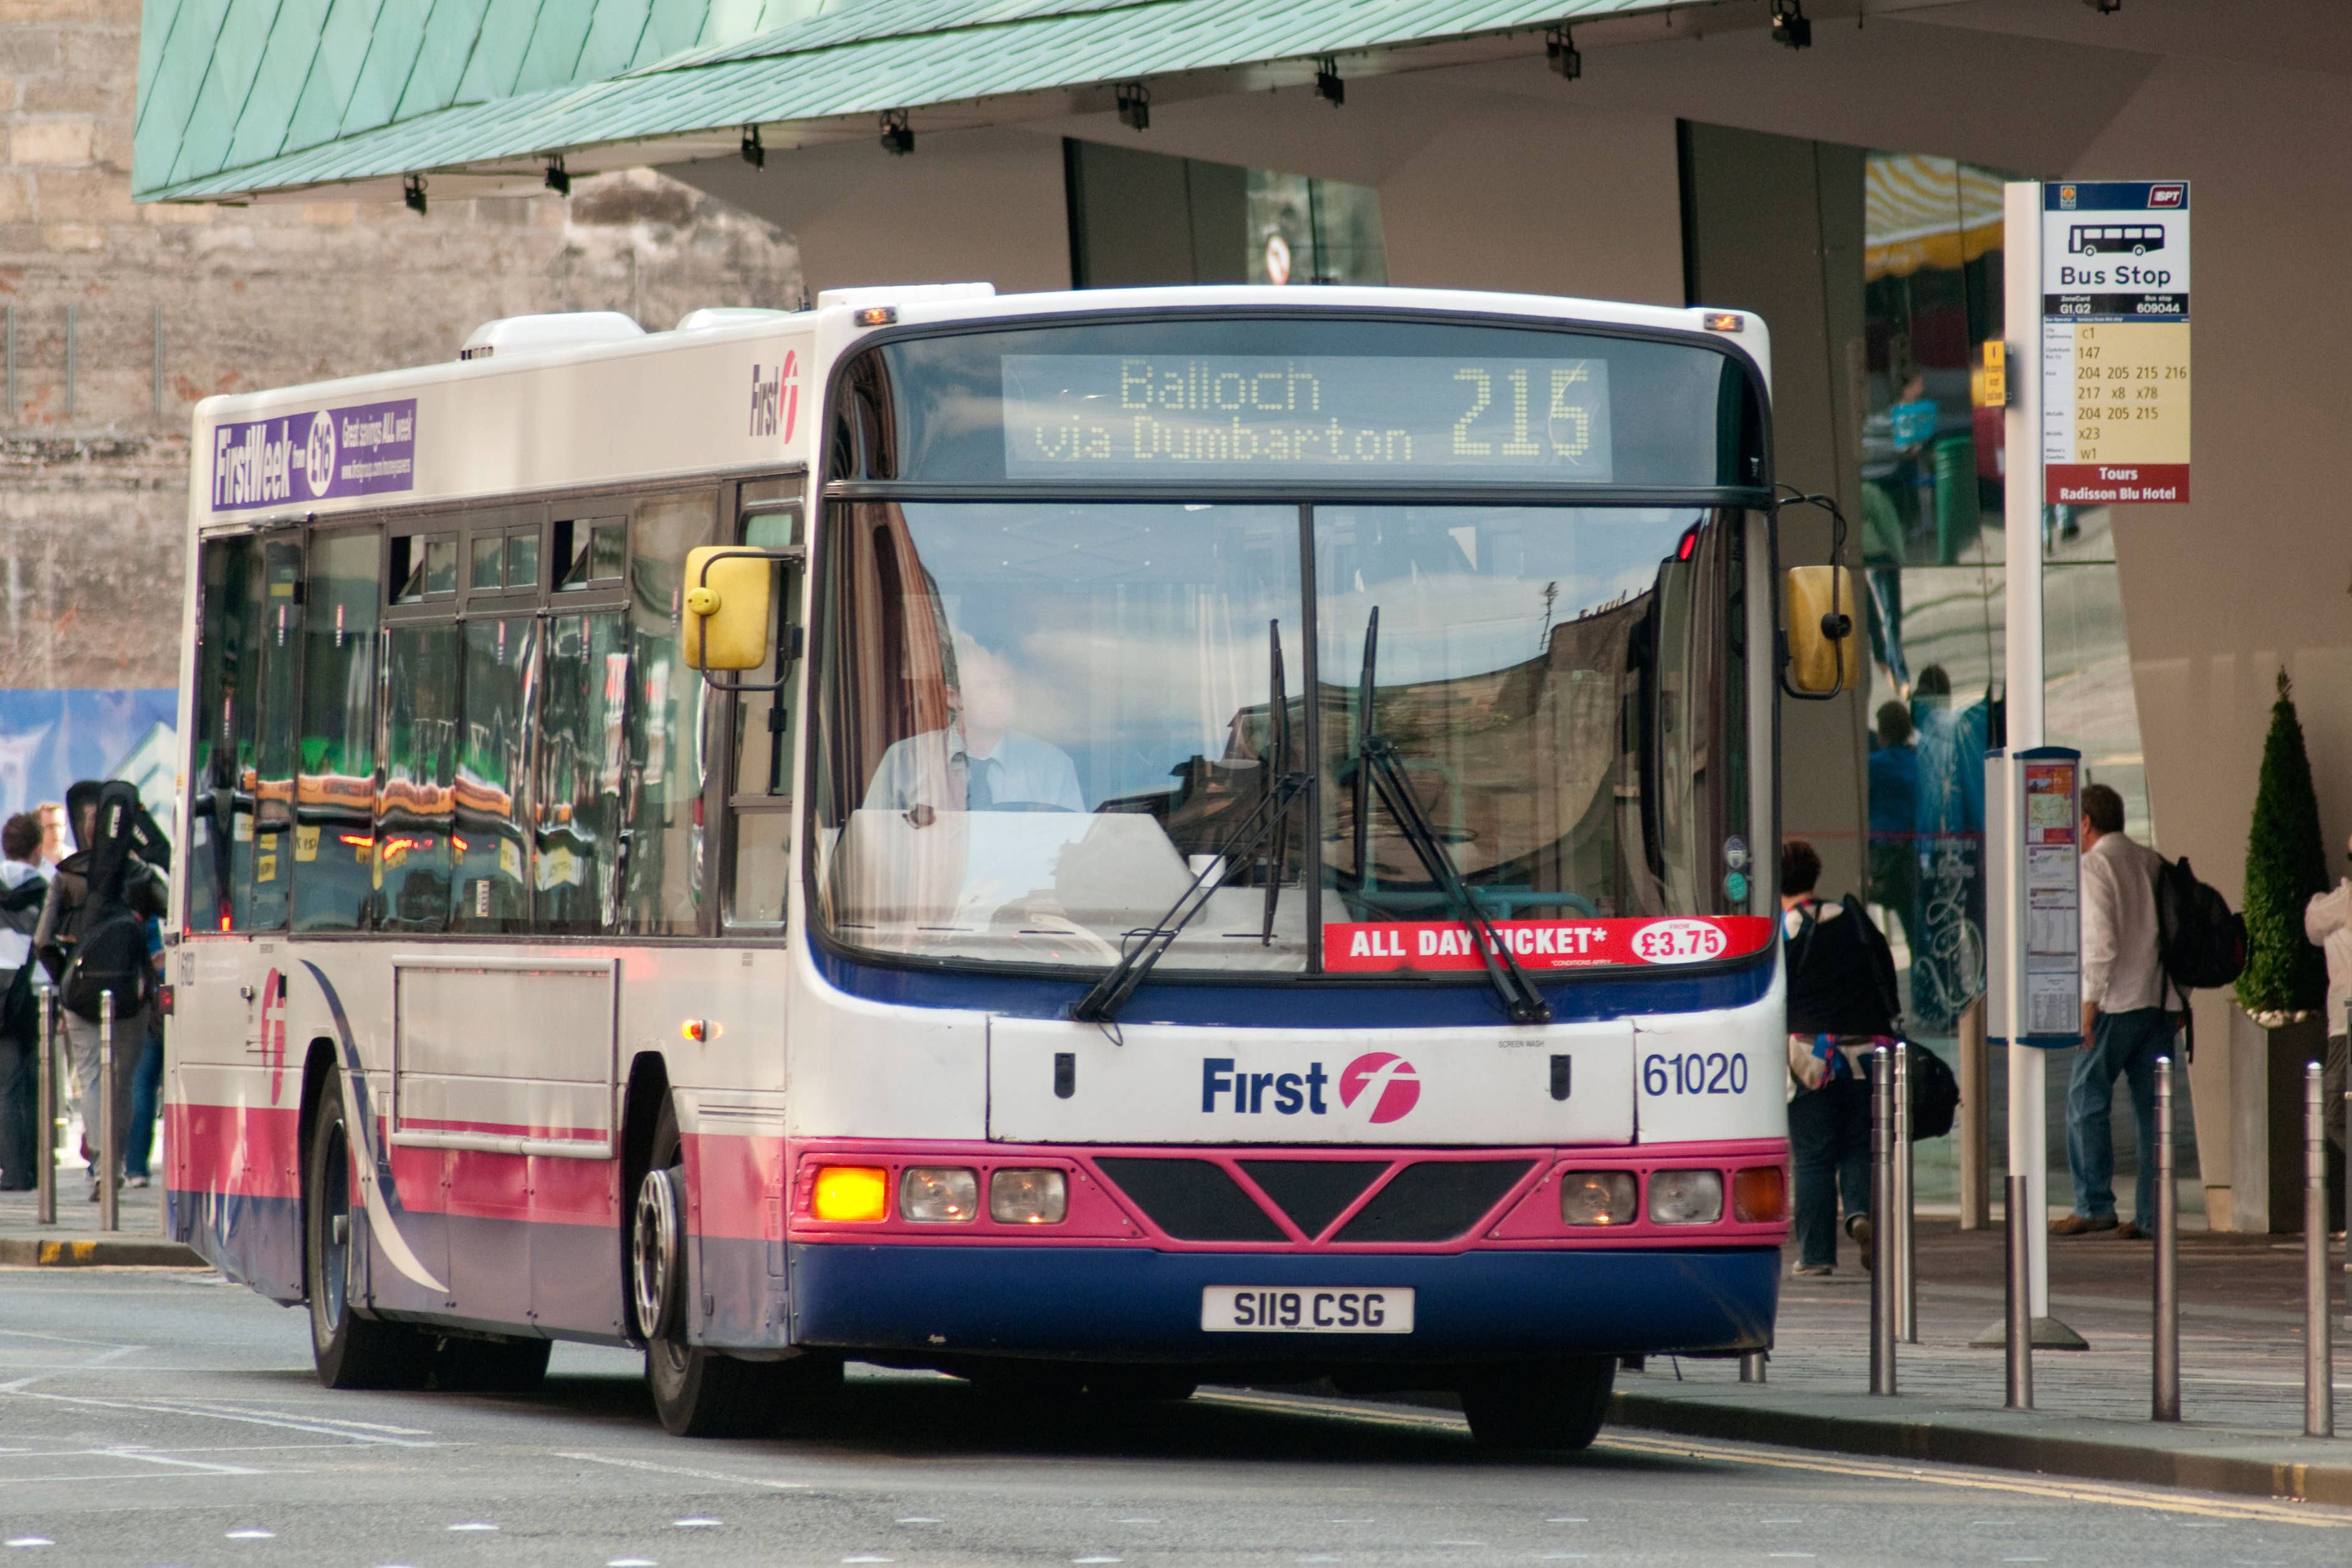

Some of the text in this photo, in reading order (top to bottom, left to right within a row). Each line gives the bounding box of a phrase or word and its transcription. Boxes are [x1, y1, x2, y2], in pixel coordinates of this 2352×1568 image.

[2061, 265, 2171, 288] Bus Stop
[2136, 303, 2181, 313] 609044
[2082, 327, 2095, 339] c1
[2079, 347, 2101, 359] 147
[2078, 366, 2187, 380] 204 205 215 216
[1121, 359, 1319, 410] Balloch
[2078, 386, 2158, 399] 217 x8 x78
[749, 364, 779, 437] First
[1453, 368, 1589, 456] 215
[2078, 407, 2159, 419] 204 205 215
[1036, 414, 1412, 460] via Dumbarton
[2078, 427, 2100, 440] x23
[2080, 447, 2096, 459] w1
[214, 420, 292, 505] FirstWeek
[2098, 467, 2138, 480] Tours
[2060, 486, 2176, 500] Radisson Blu Hotel
[1349, 930, 1407, 957] ALL
[1418, 929, 1475, 956] DAY
[1641, 929, 1720, 957] £3.75
[1498, 1040, 1546, 1048] SCREEN WASH
[1643, 1052, 1748, 1097] 61020
[1202, 1058, 1328, 1115] First
[1233, 1292, 1385, 1327] S119 CSG
